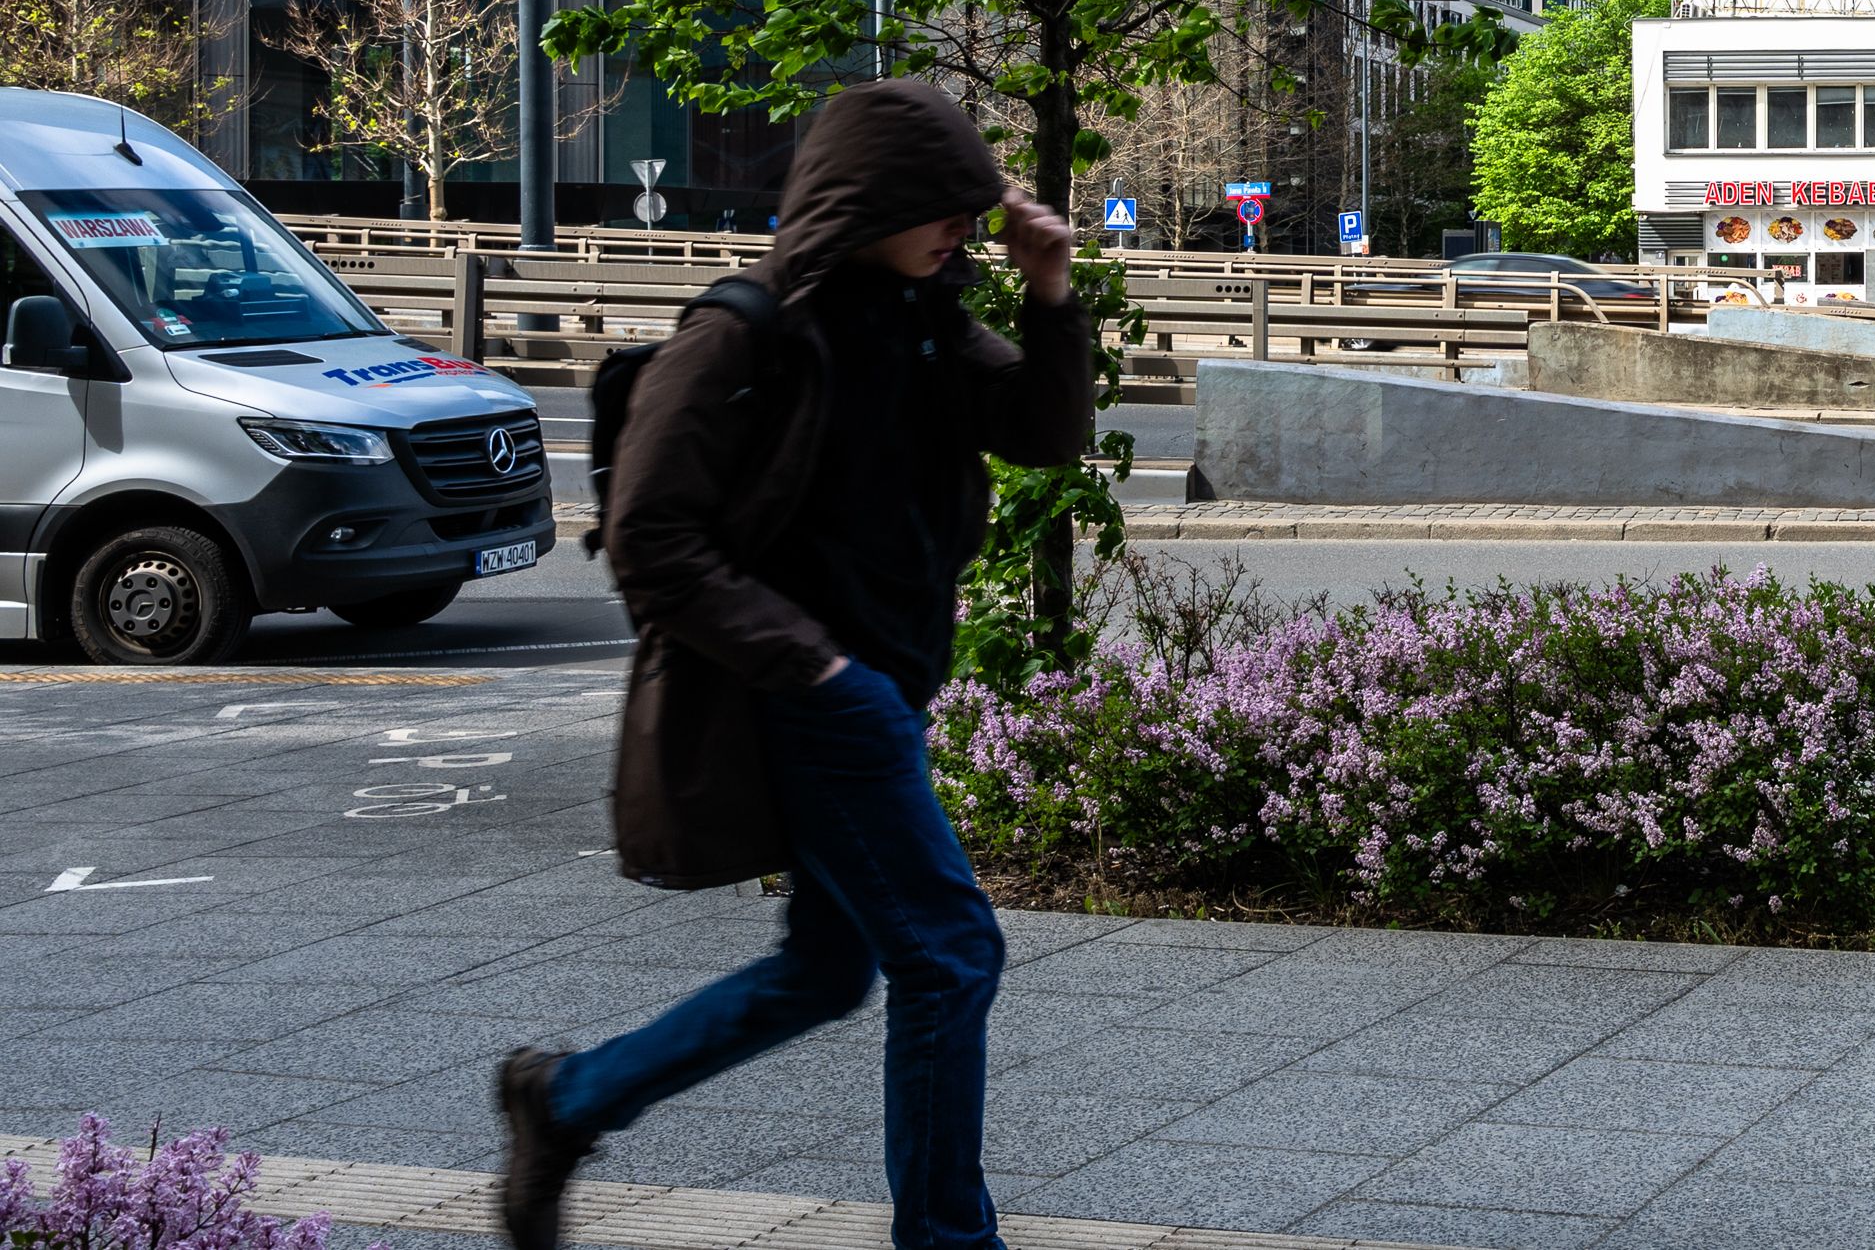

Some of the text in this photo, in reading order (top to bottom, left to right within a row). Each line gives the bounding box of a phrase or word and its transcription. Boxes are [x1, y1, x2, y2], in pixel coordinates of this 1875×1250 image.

[1704, 181, 1774, 206] ADEN
[54, 218, 159, 239] WARSZAWA
[1344, 215, 1357, 234] P
[482, 543, 534, 572] WZW 40401
